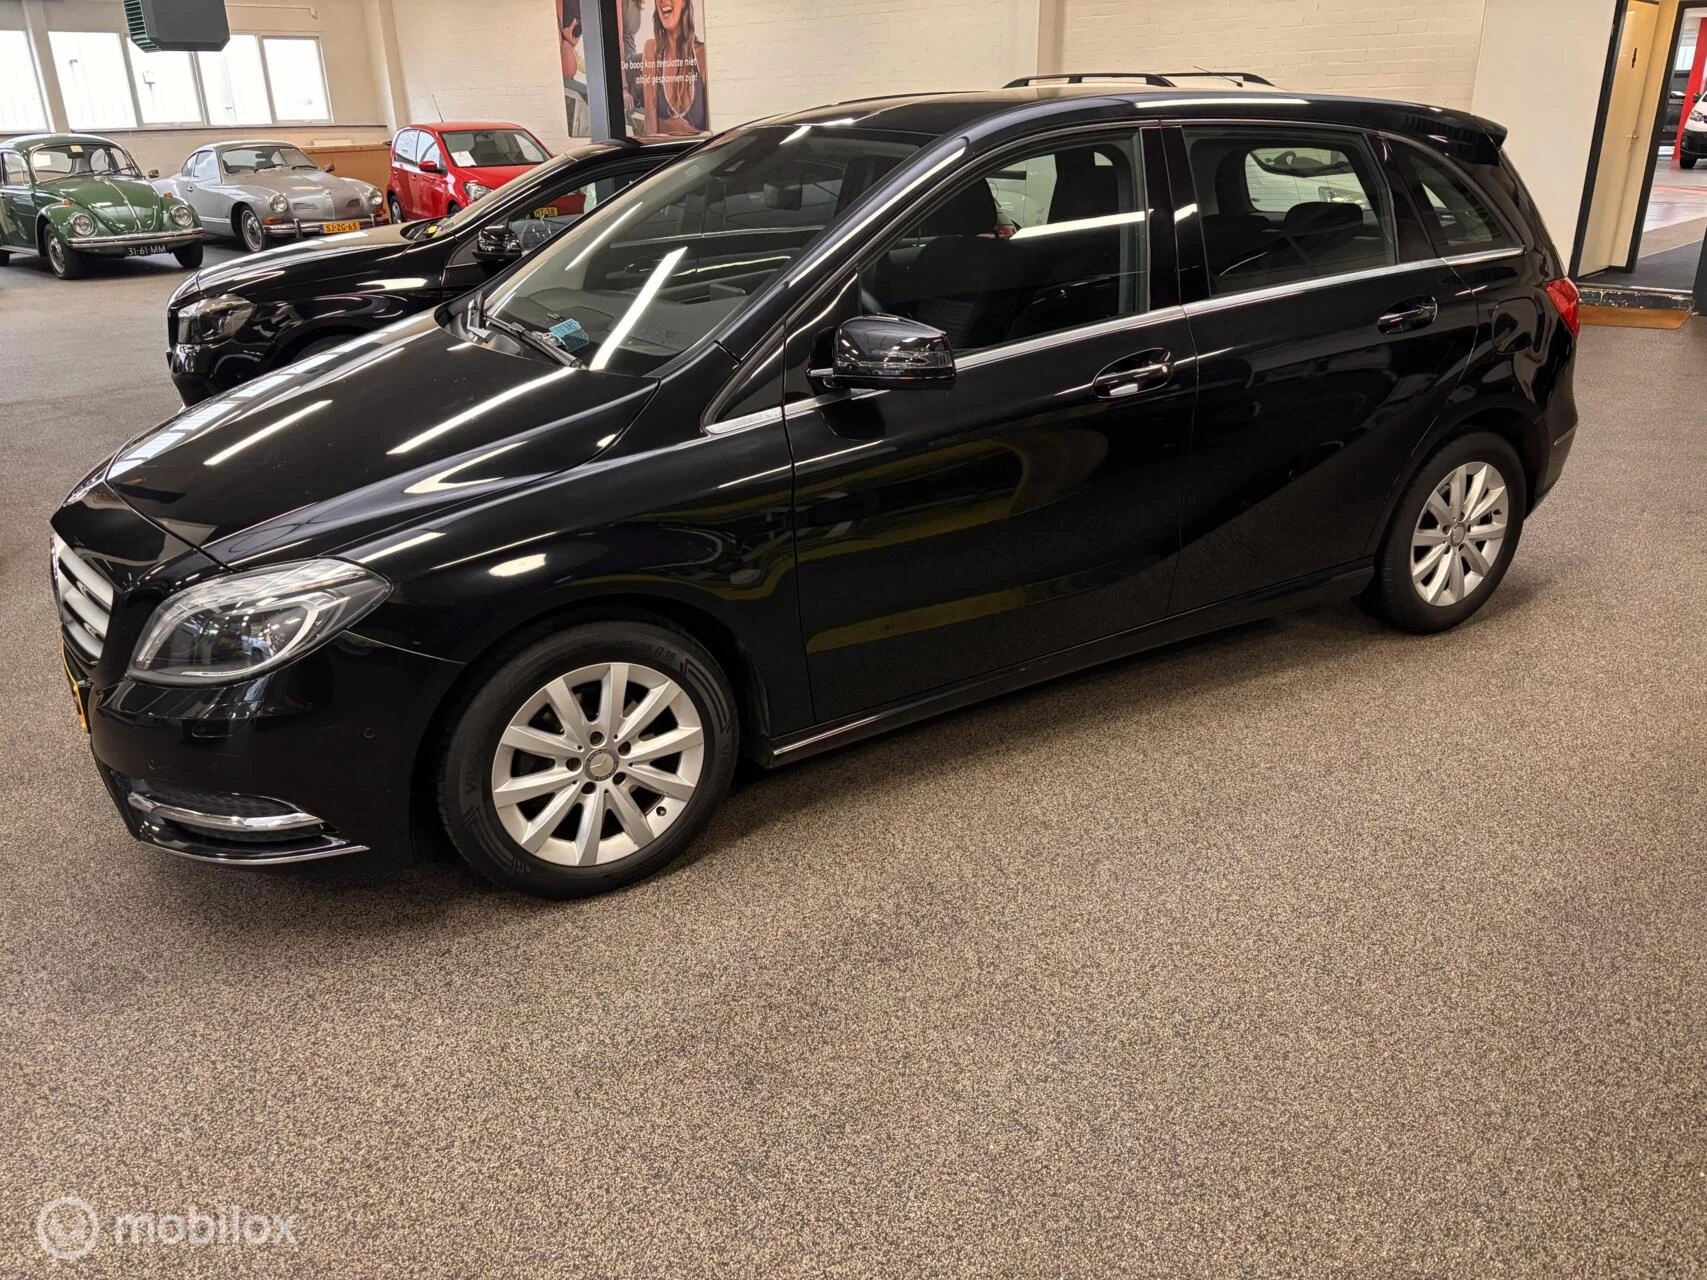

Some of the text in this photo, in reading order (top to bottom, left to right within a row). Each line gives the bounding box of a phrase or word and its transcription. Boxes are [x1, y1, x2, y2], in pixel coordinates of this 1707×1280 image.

[629, 60, 643, 71] boog
[644, 60, 656, 69] kan
[651, 75, 684, 85] gespannen
